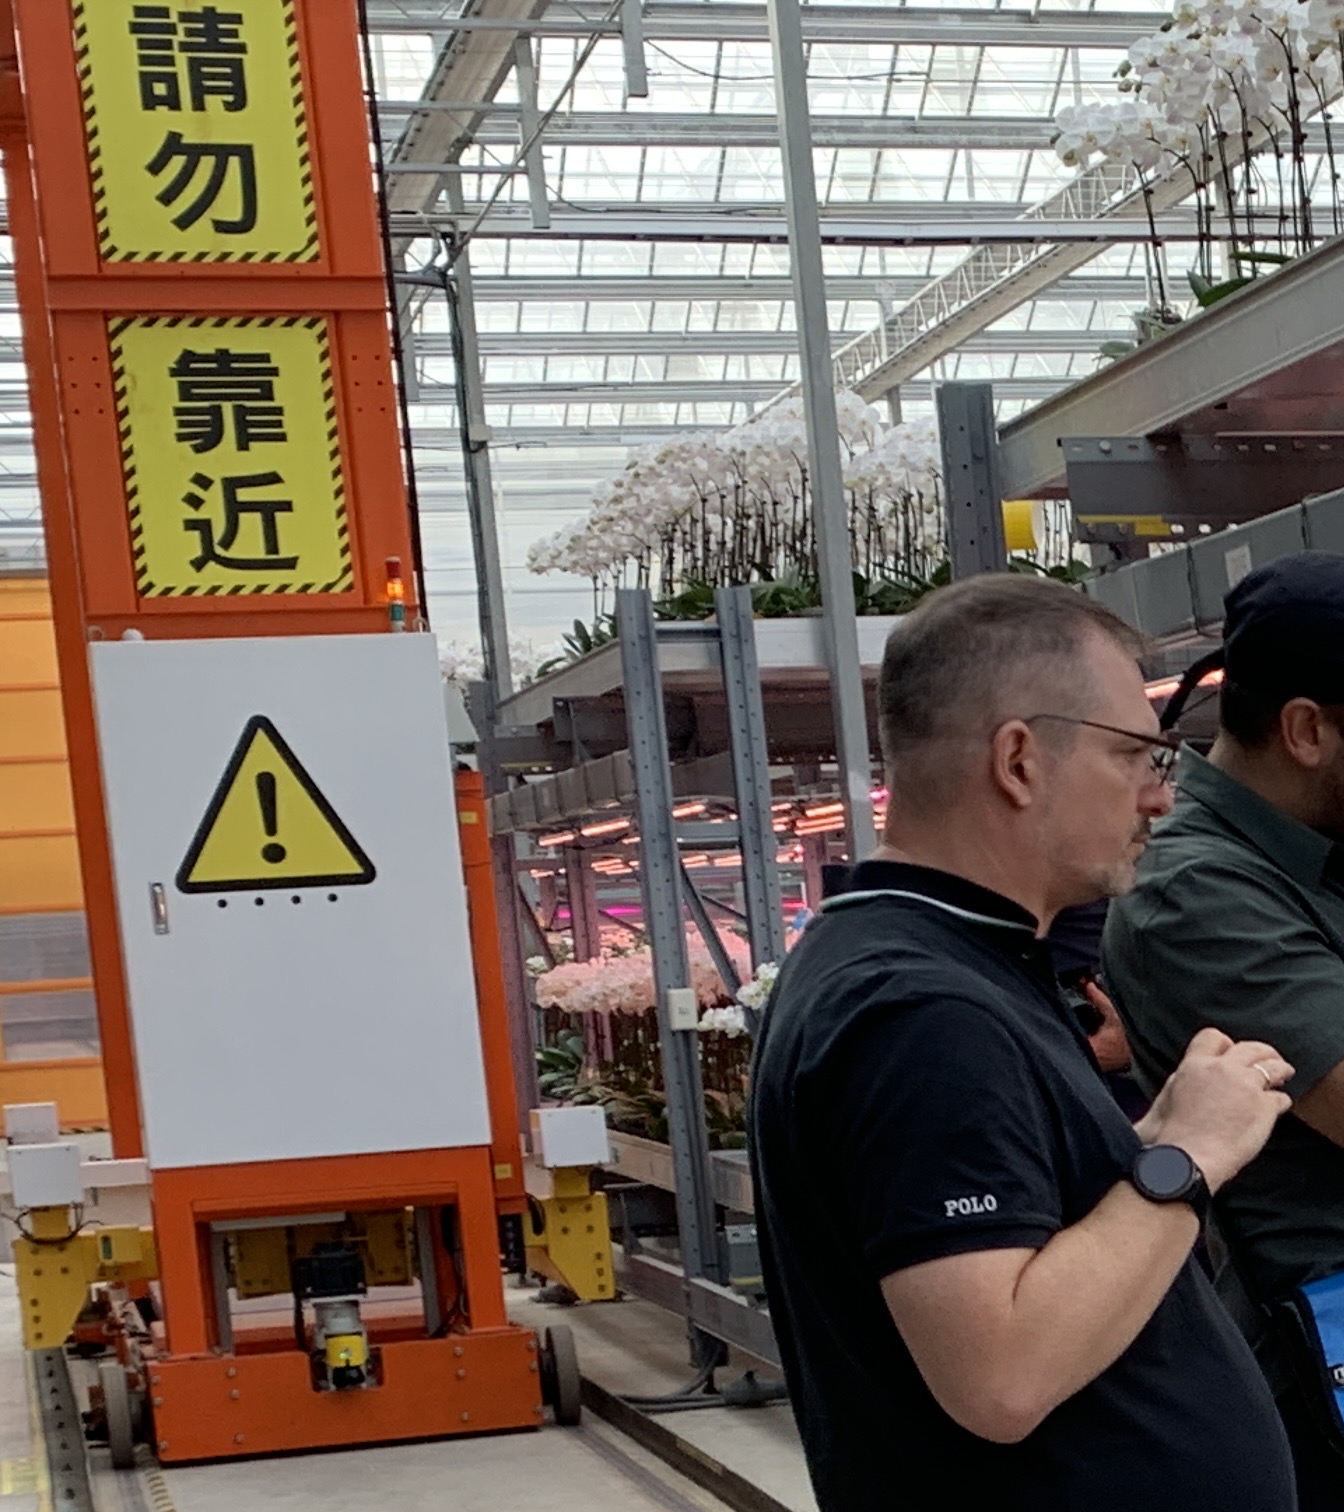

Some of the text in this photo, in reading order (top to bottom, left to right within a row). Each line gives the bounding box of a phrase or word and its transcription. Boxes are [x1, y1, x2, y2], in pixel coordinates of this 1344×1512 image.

[127, 5, 259, 236] 請勿
[168, 347, 299, 573] 靠近
[944, 1194, 998, 1218] POLO
